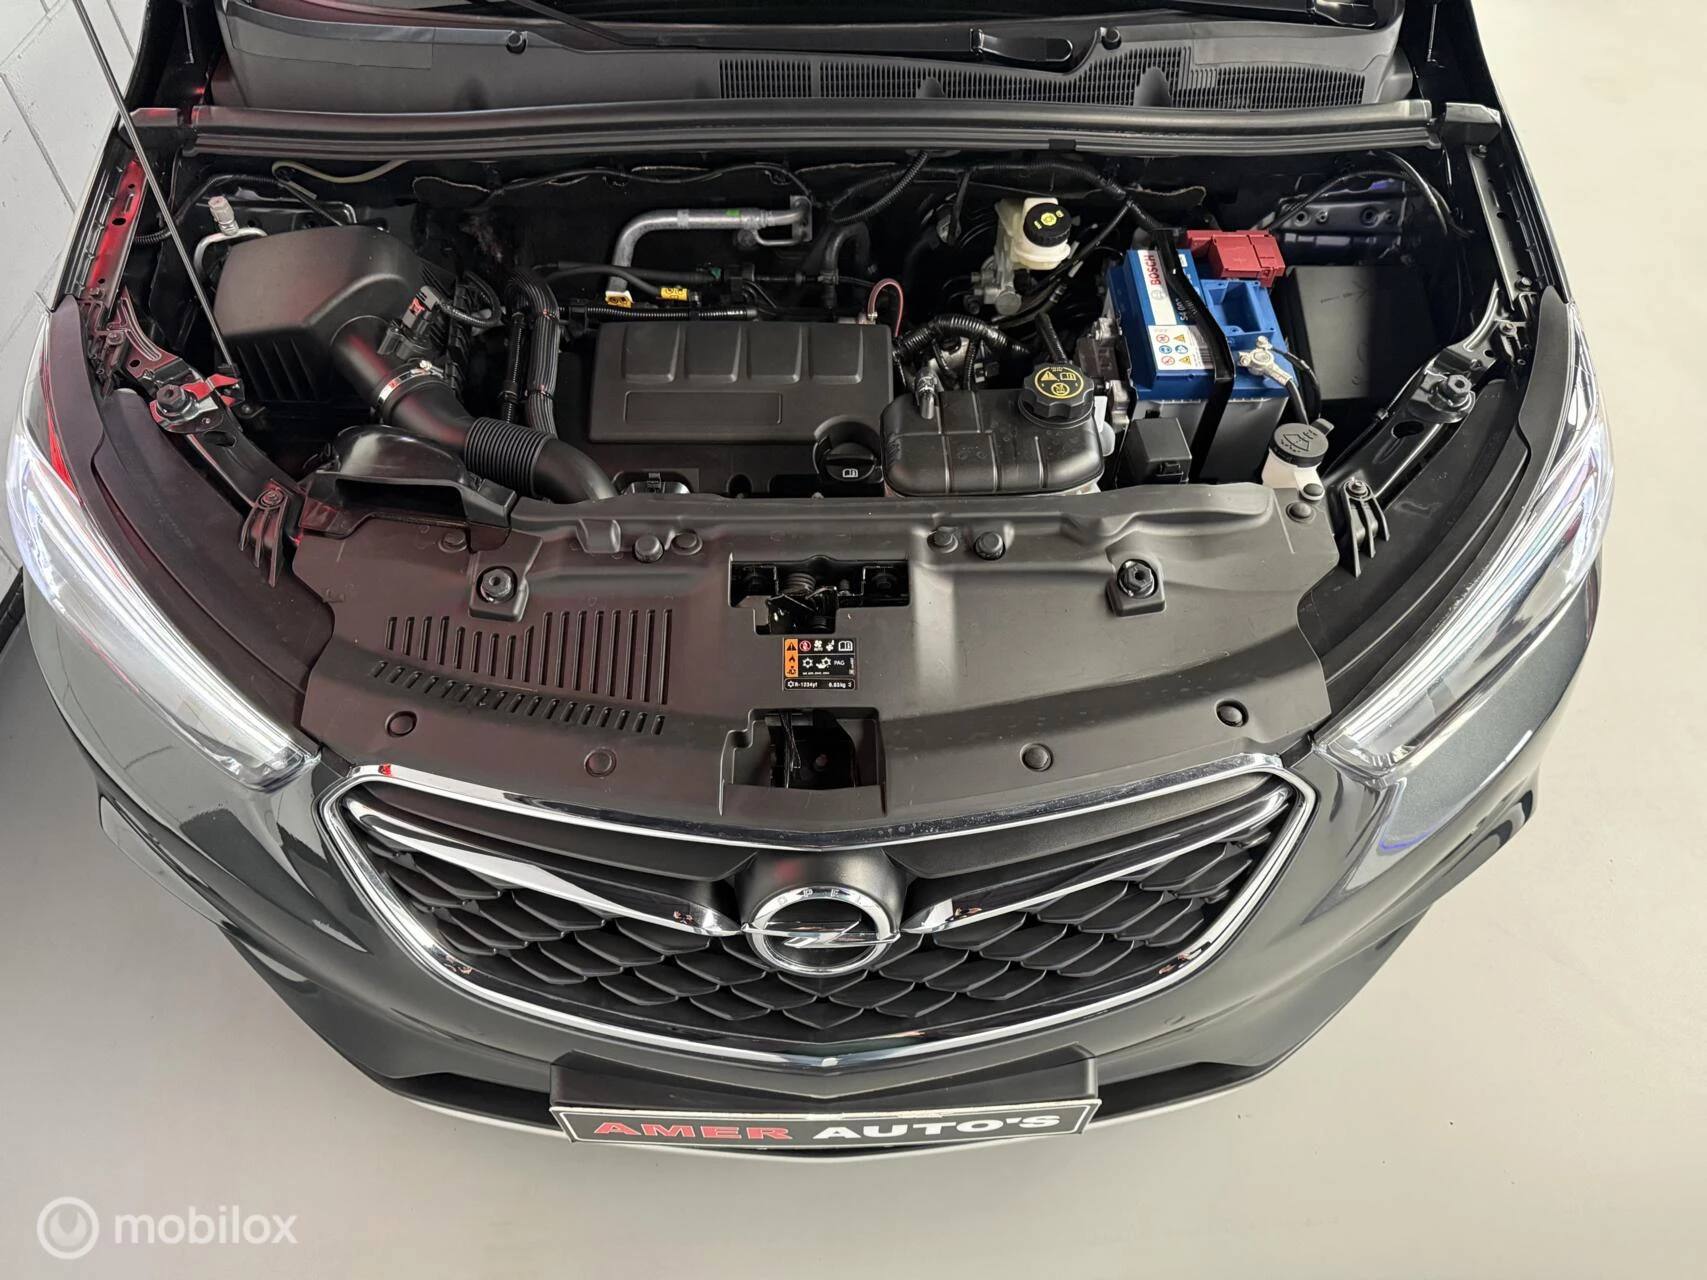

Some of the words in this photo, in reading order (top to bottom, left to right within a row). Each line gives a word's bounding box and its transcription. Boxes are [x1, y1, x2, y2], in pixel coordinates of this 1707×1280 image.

[1143, 254, 1161, 286] BOSCH
[777, 887, 863, 906] OPEL
[594, 1122, 793, 1140] AMER
[812, 1115, 1061, 1140] AUTO'S
